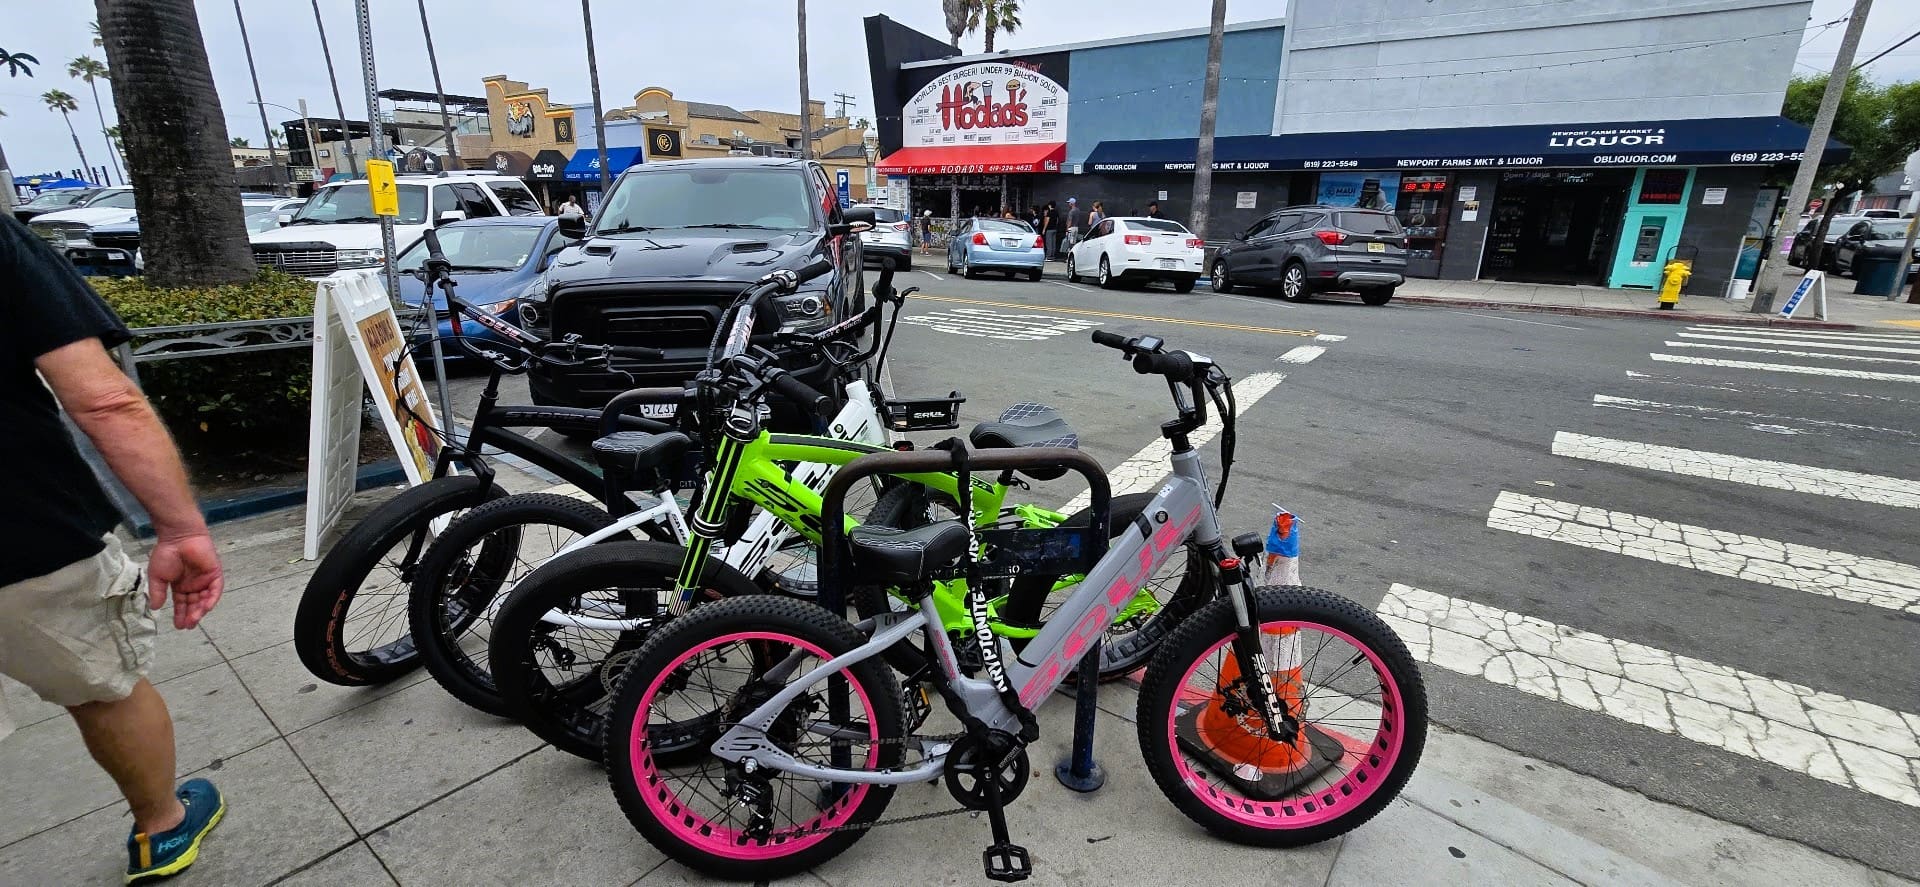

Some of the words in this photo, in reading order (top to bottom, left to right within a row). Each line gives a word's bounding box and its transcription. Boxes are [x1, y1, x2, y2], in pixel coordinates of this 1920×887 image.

[914, 82, 937, 105] WORLDS
[938, 75, 951, 86] BEST
[953, 68, 978, 80] BURGER!
[981, 66, 1002, 74] UNDER
[1014, 69, 1039, 83] BILLION
[1040, 80, 1057, 96] SOLD!
[936, 79, 1028, 130] Hodad's
[1549, 135, 1665, 147] LIQUOR
[940, 164, 984, 174] HODAD'S
[1243, 162, 1270, 170] LIQUOR
[1304, 160, 1320, 169] (619)
[1322, 159, 1358, 168] 223-5549
[1397, 159, 1439, 167] NEWPORT
[1442, 158, 1472, 166] FARMS
[1474, 158, 1494, 166] MKT
[1497, 157, 1505, 166] &
[1507, 157, 1543, 165] LIQUOR
[1593, 154, 1677, 164] OBLIQUOR.COM
[1730, 152, 1758, 162] (619)
[1760, 152, 1804, 162] 223-55
[839, 174, 846, 187] P
[1019, 505, 1201, 709] SOUL
[972, 588, 1008, 694] KRYPTONITE
[1252, 652, 1285, 734] SOUL
